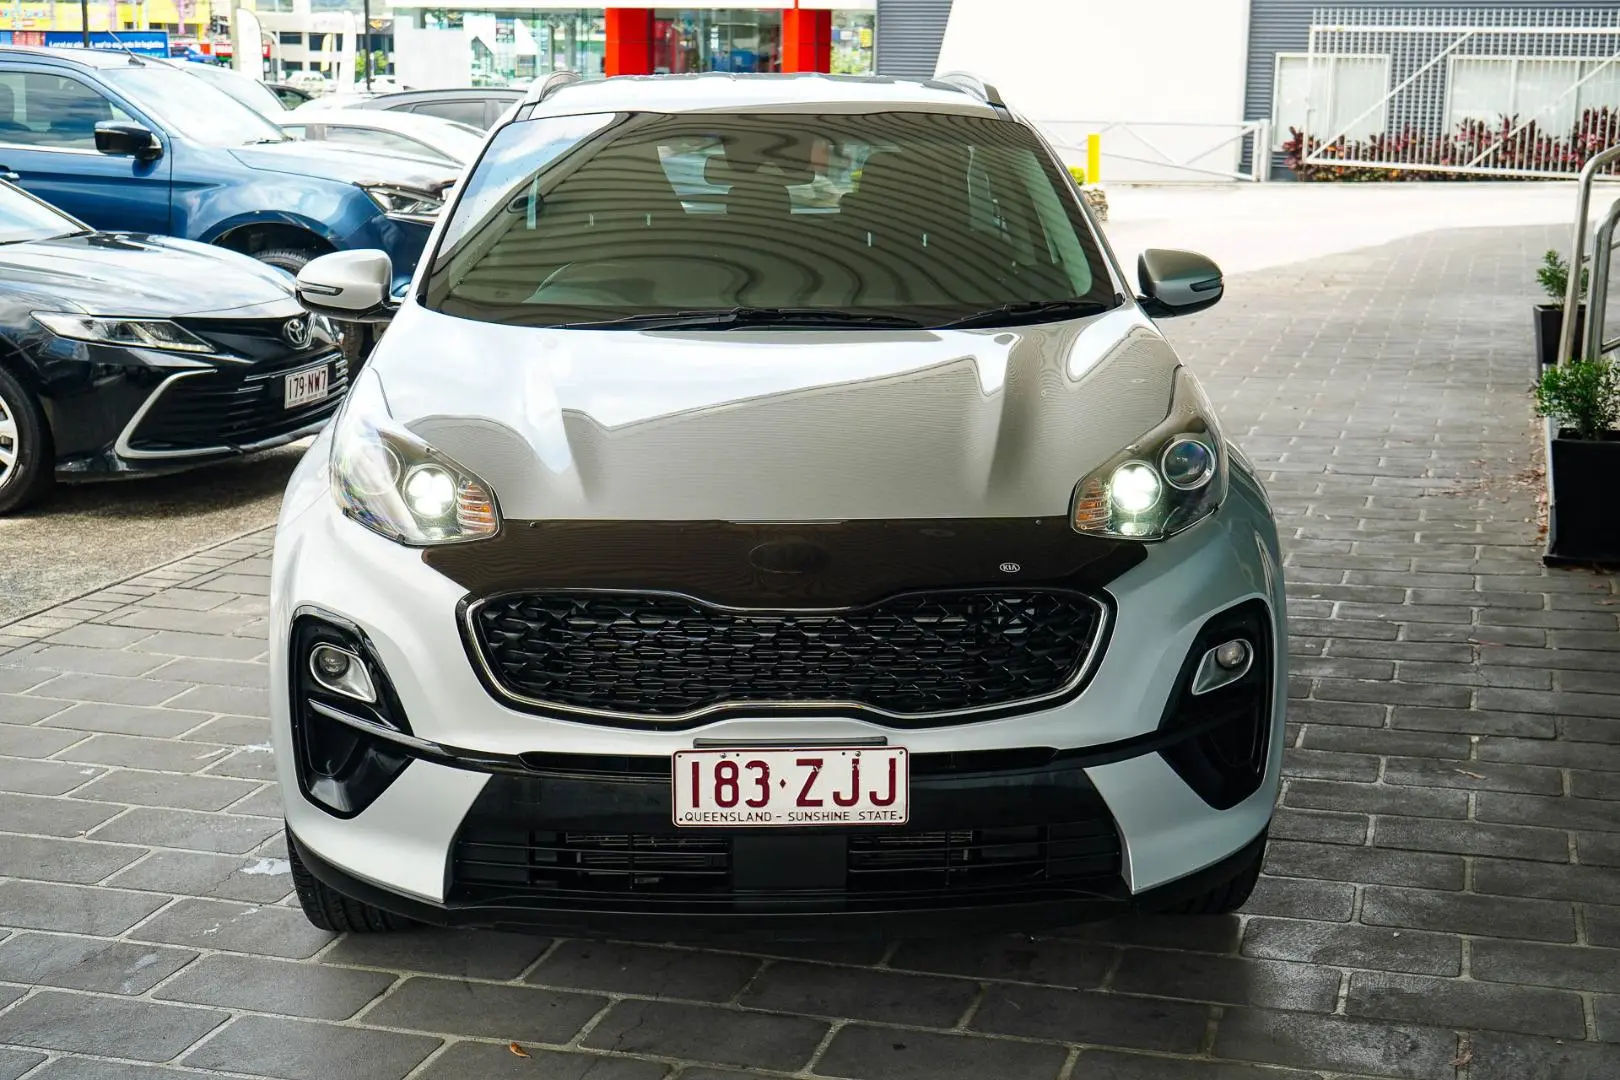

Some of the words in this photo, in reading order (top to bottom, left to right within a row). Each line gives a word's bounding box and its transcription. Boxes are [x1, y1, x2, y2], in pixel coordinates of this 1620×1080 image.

[691, 760, 770, 808] 183
[796, 757, 897, 807] ZJJ
[684, 811, 772, 822] QUEENSLAND
[788, 811, 850, 822] SUNSHINE
[858, 810, 898, 821] STATE
